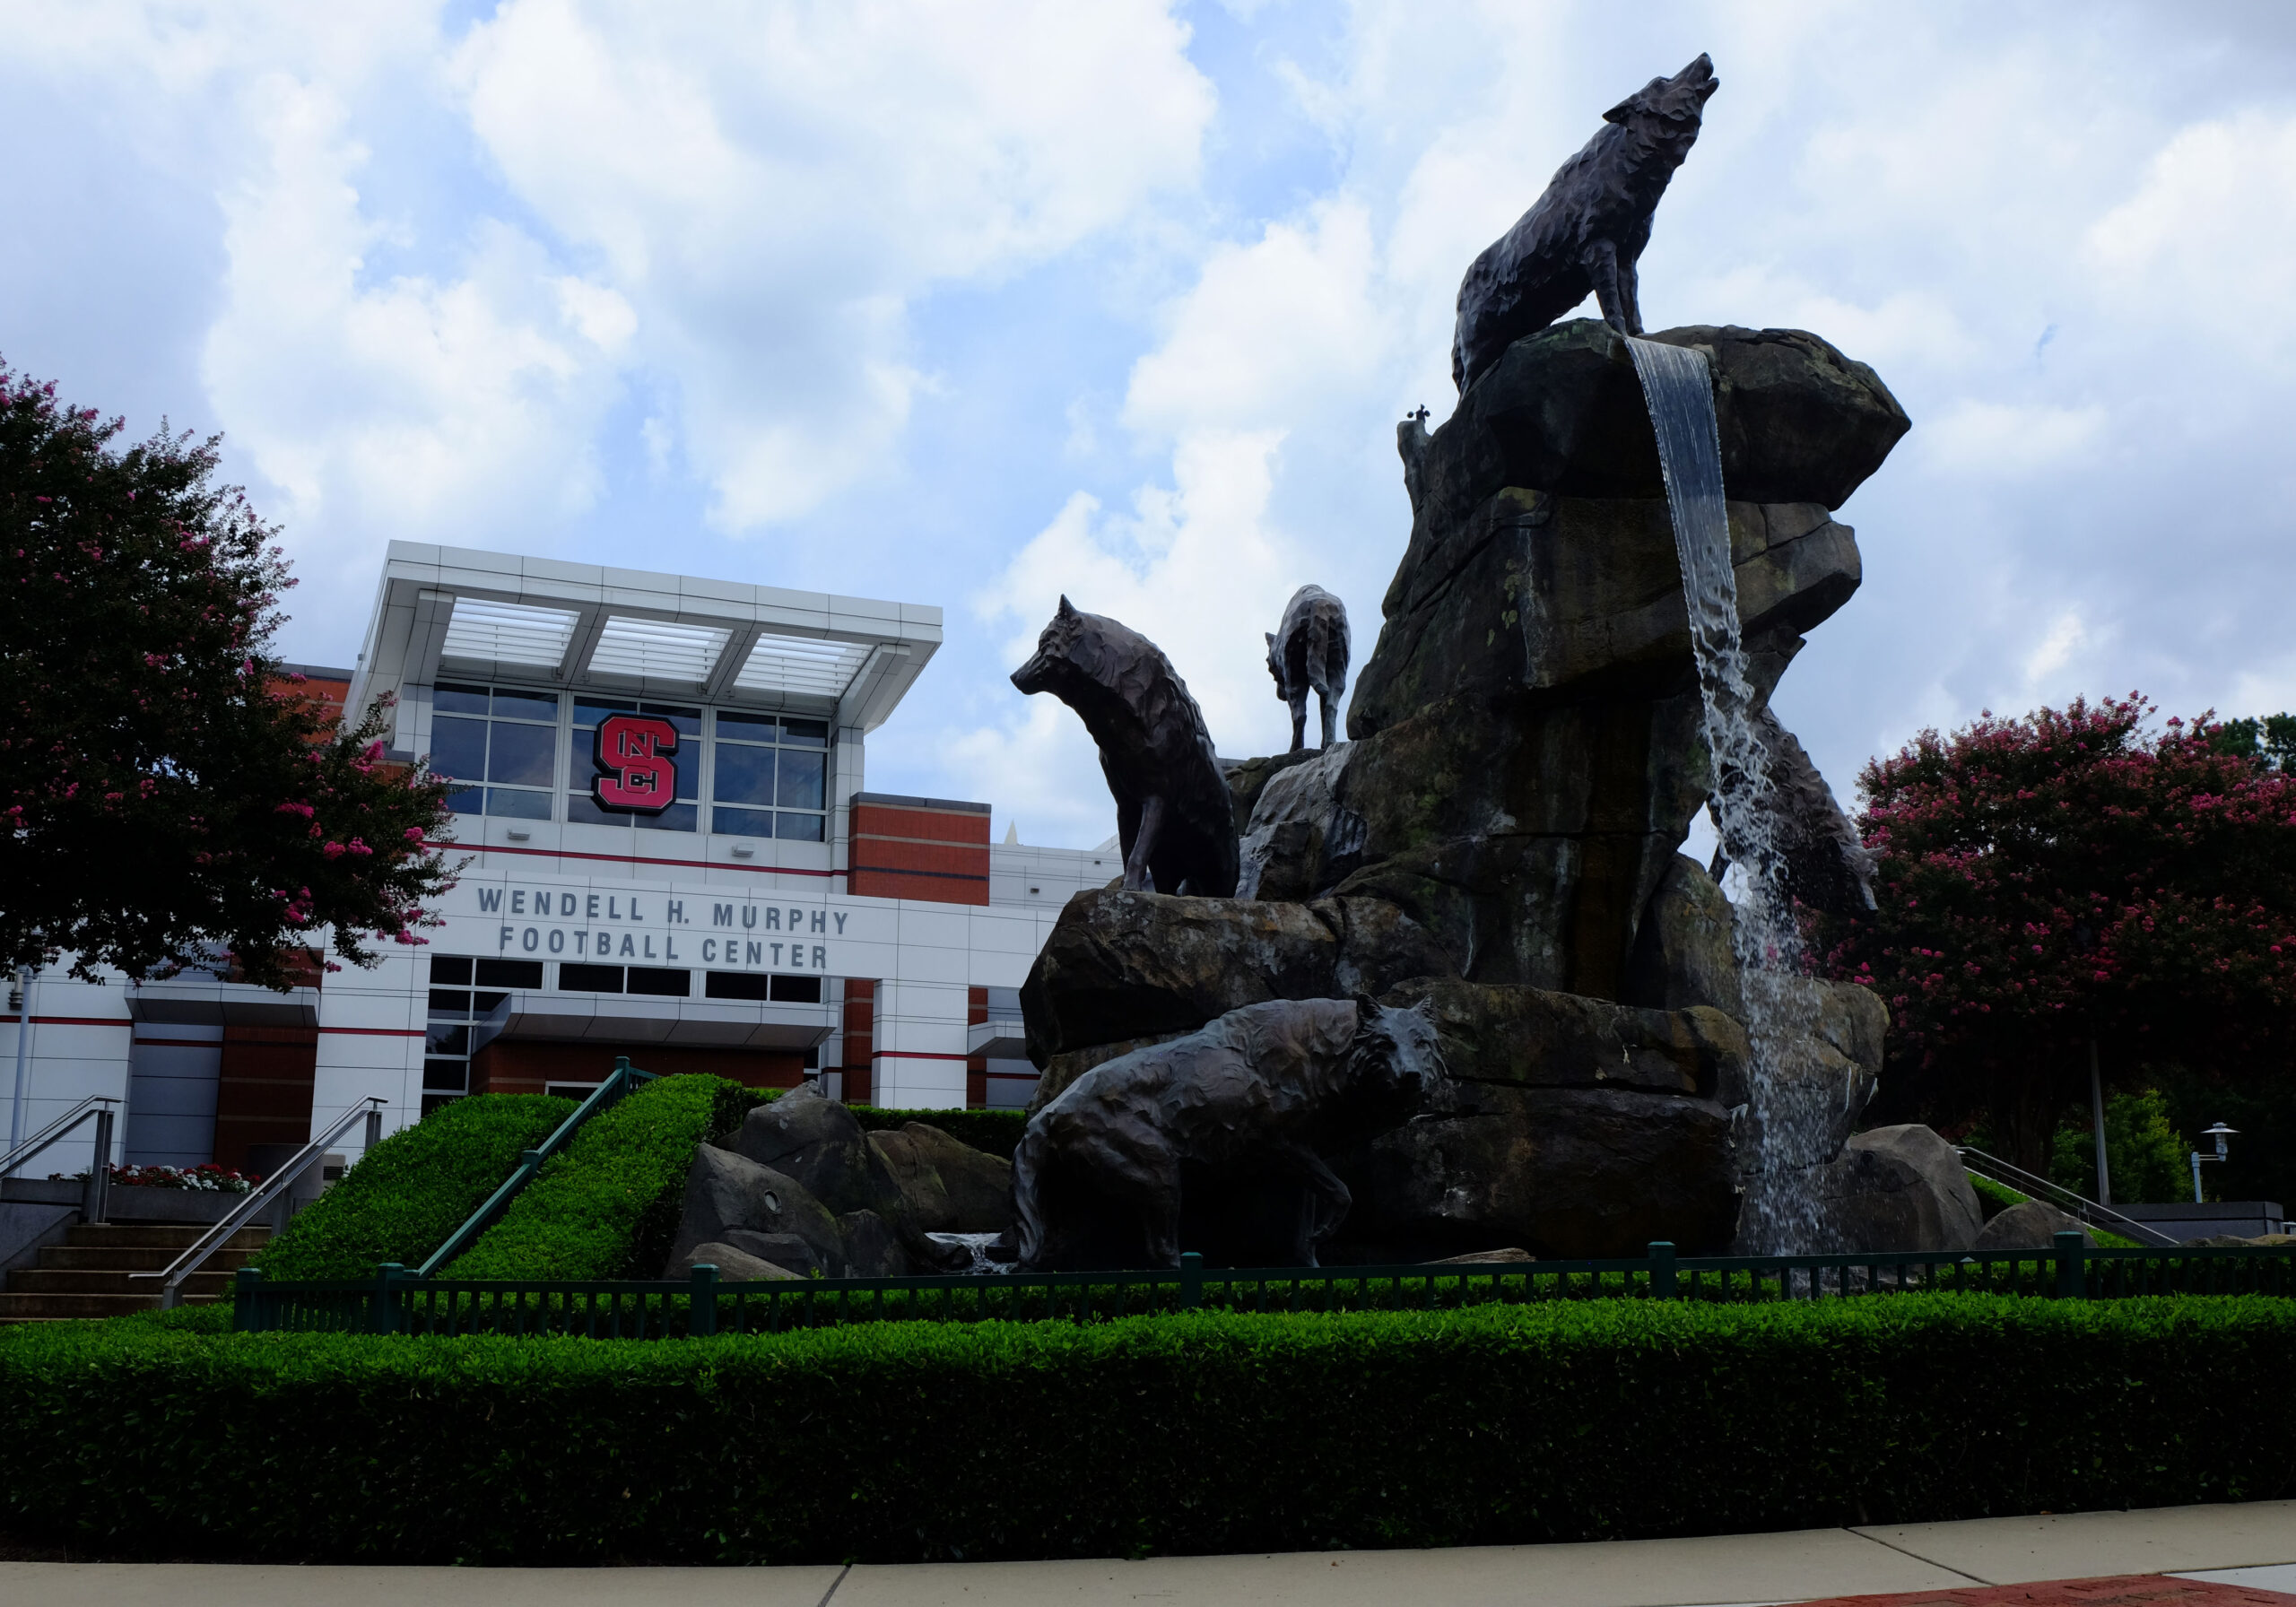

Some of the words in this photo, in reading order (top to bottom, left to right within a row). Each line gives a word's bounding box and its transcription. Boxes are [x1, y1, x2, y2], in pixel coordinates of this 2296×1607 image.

[478, 888, 644, 921] WENDELL
[667, 899, 690, 925] H.
[713, 903, 848, 934] MURPHY
[499, 926, 679, 960] FOOTBALL
[702, 938, 827, 969] CENTER
